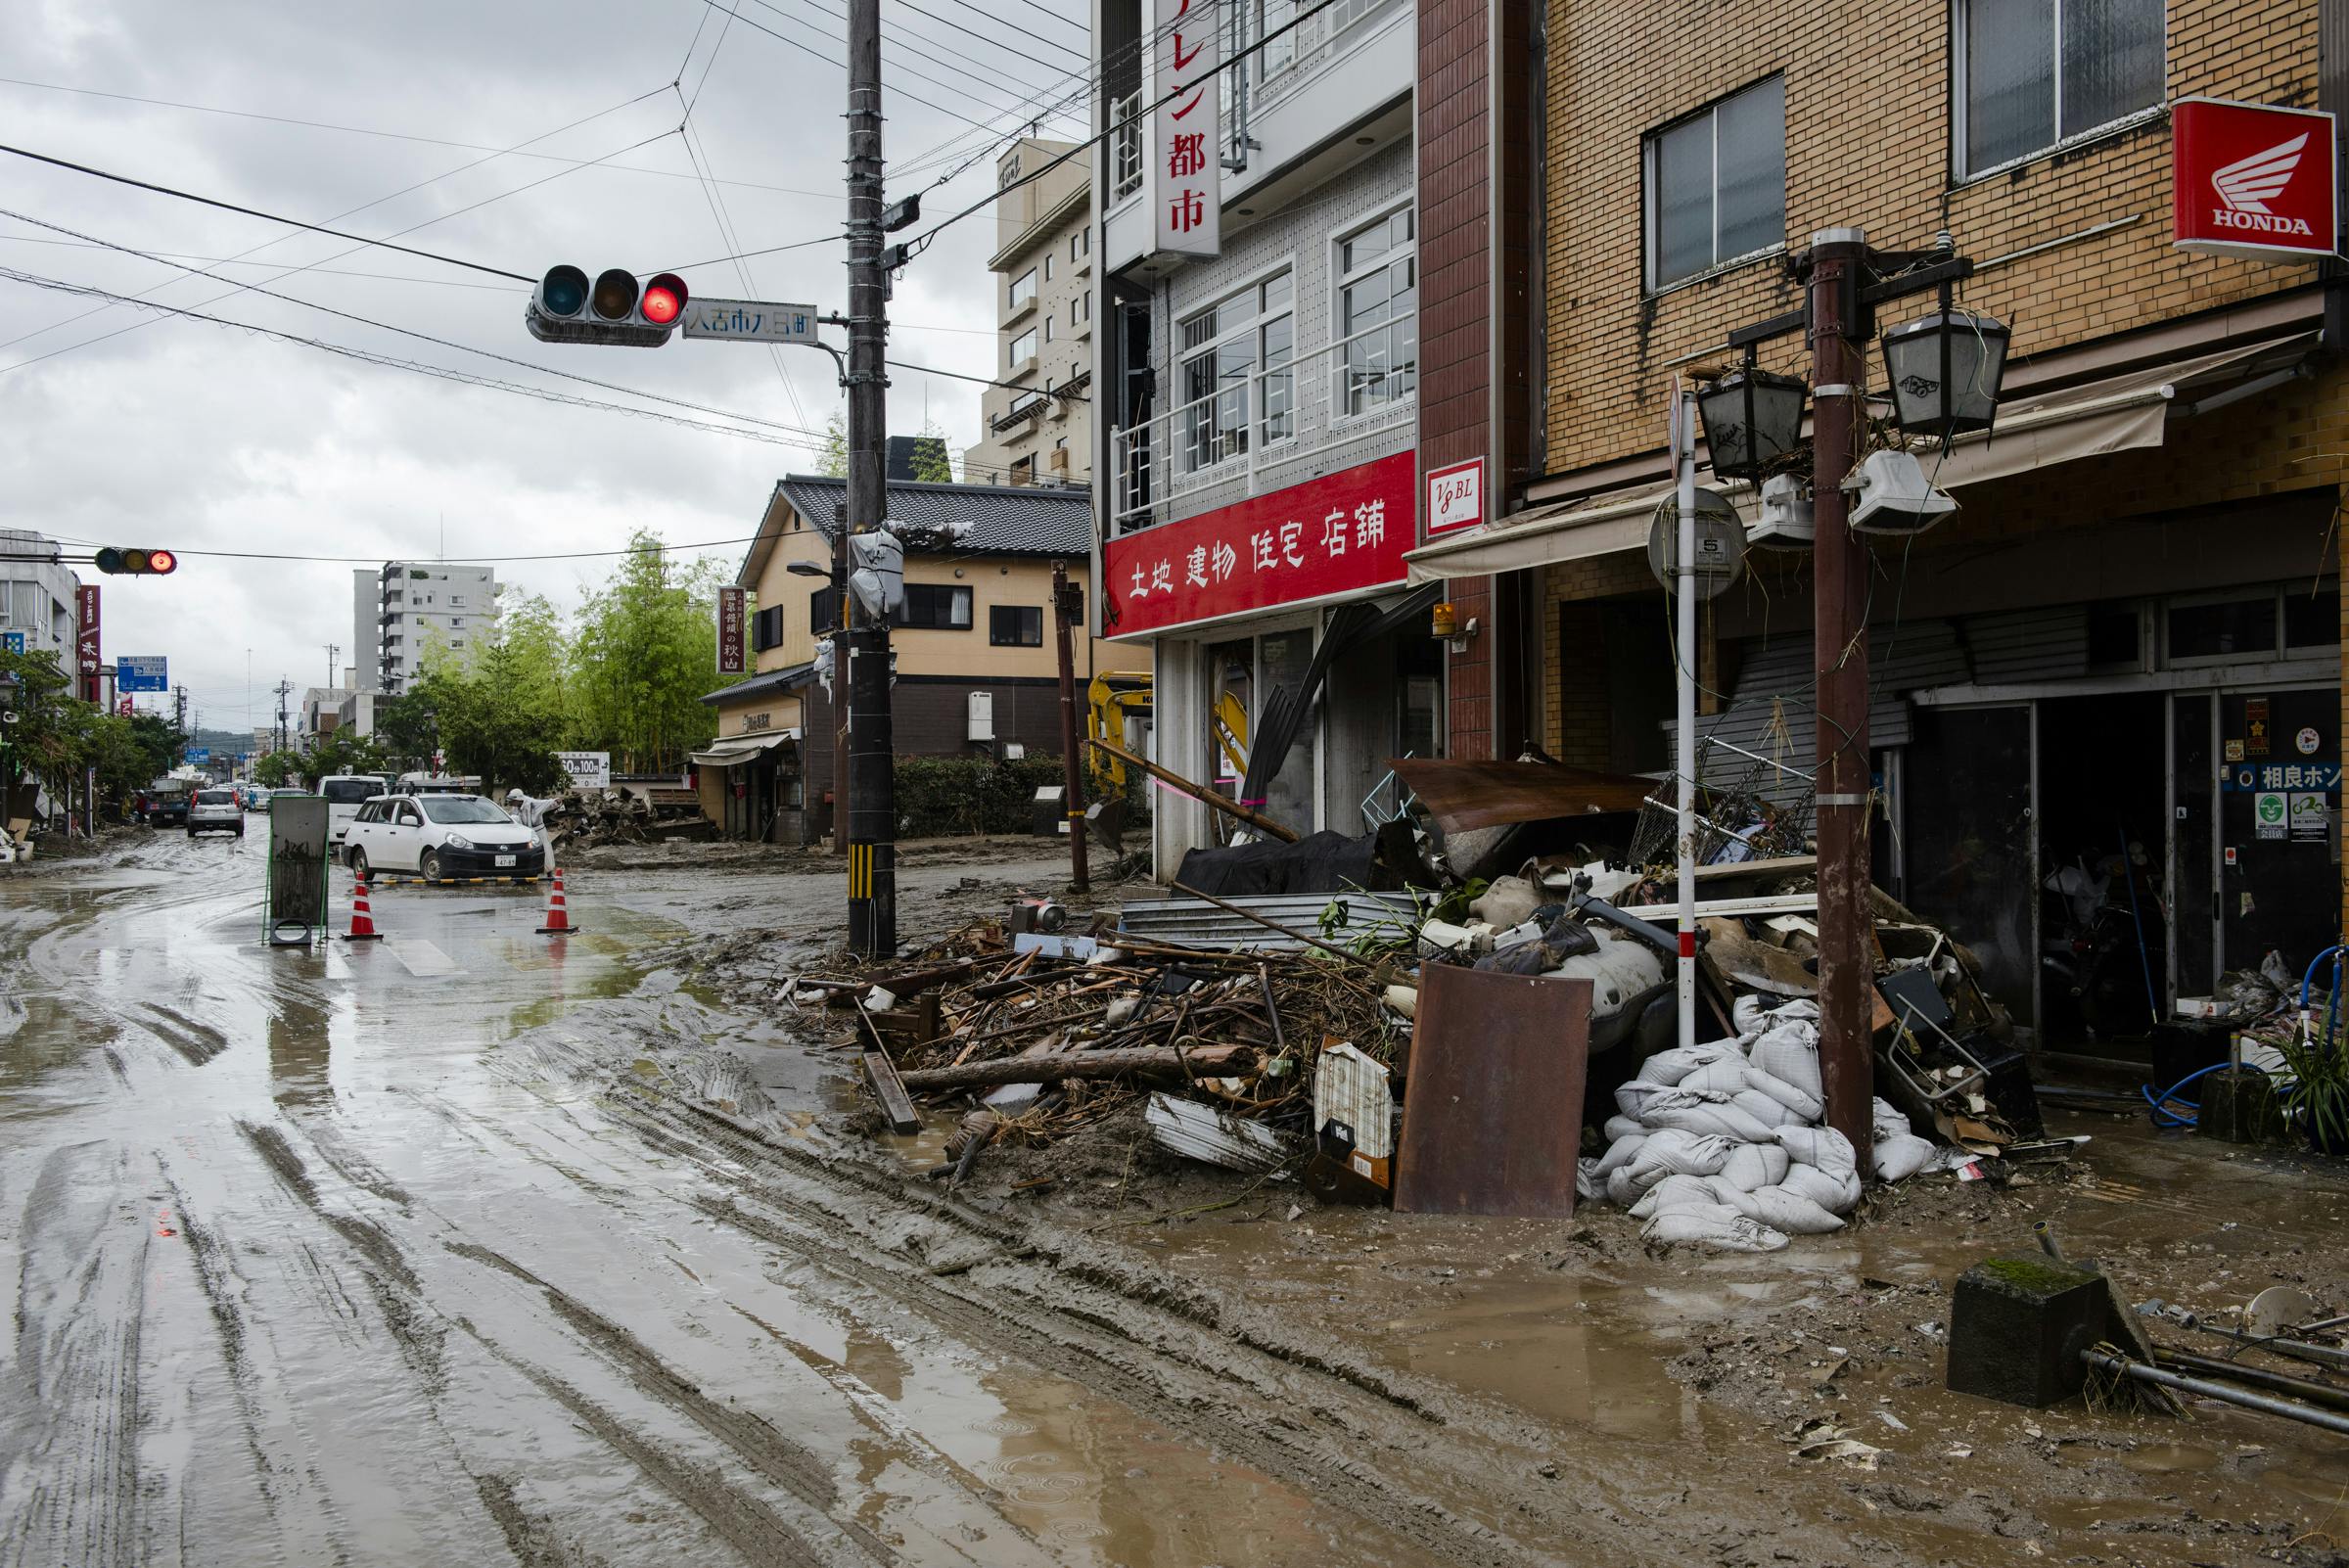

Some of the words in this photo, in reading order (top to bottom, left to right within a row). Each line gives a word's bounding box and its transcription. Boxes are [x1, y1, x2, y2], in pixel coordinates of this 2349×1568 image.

[2212, 208, 2314, 236] HONDA
[689, 306, 810, 335] 人吉市九日町
[1129, 561, 1174, 599] 土地
[1185, 539, 1237, 588] 建物
[1251, 520, 1305, 574] 住宅
[1320, 498, 1386, 559] 店舗
